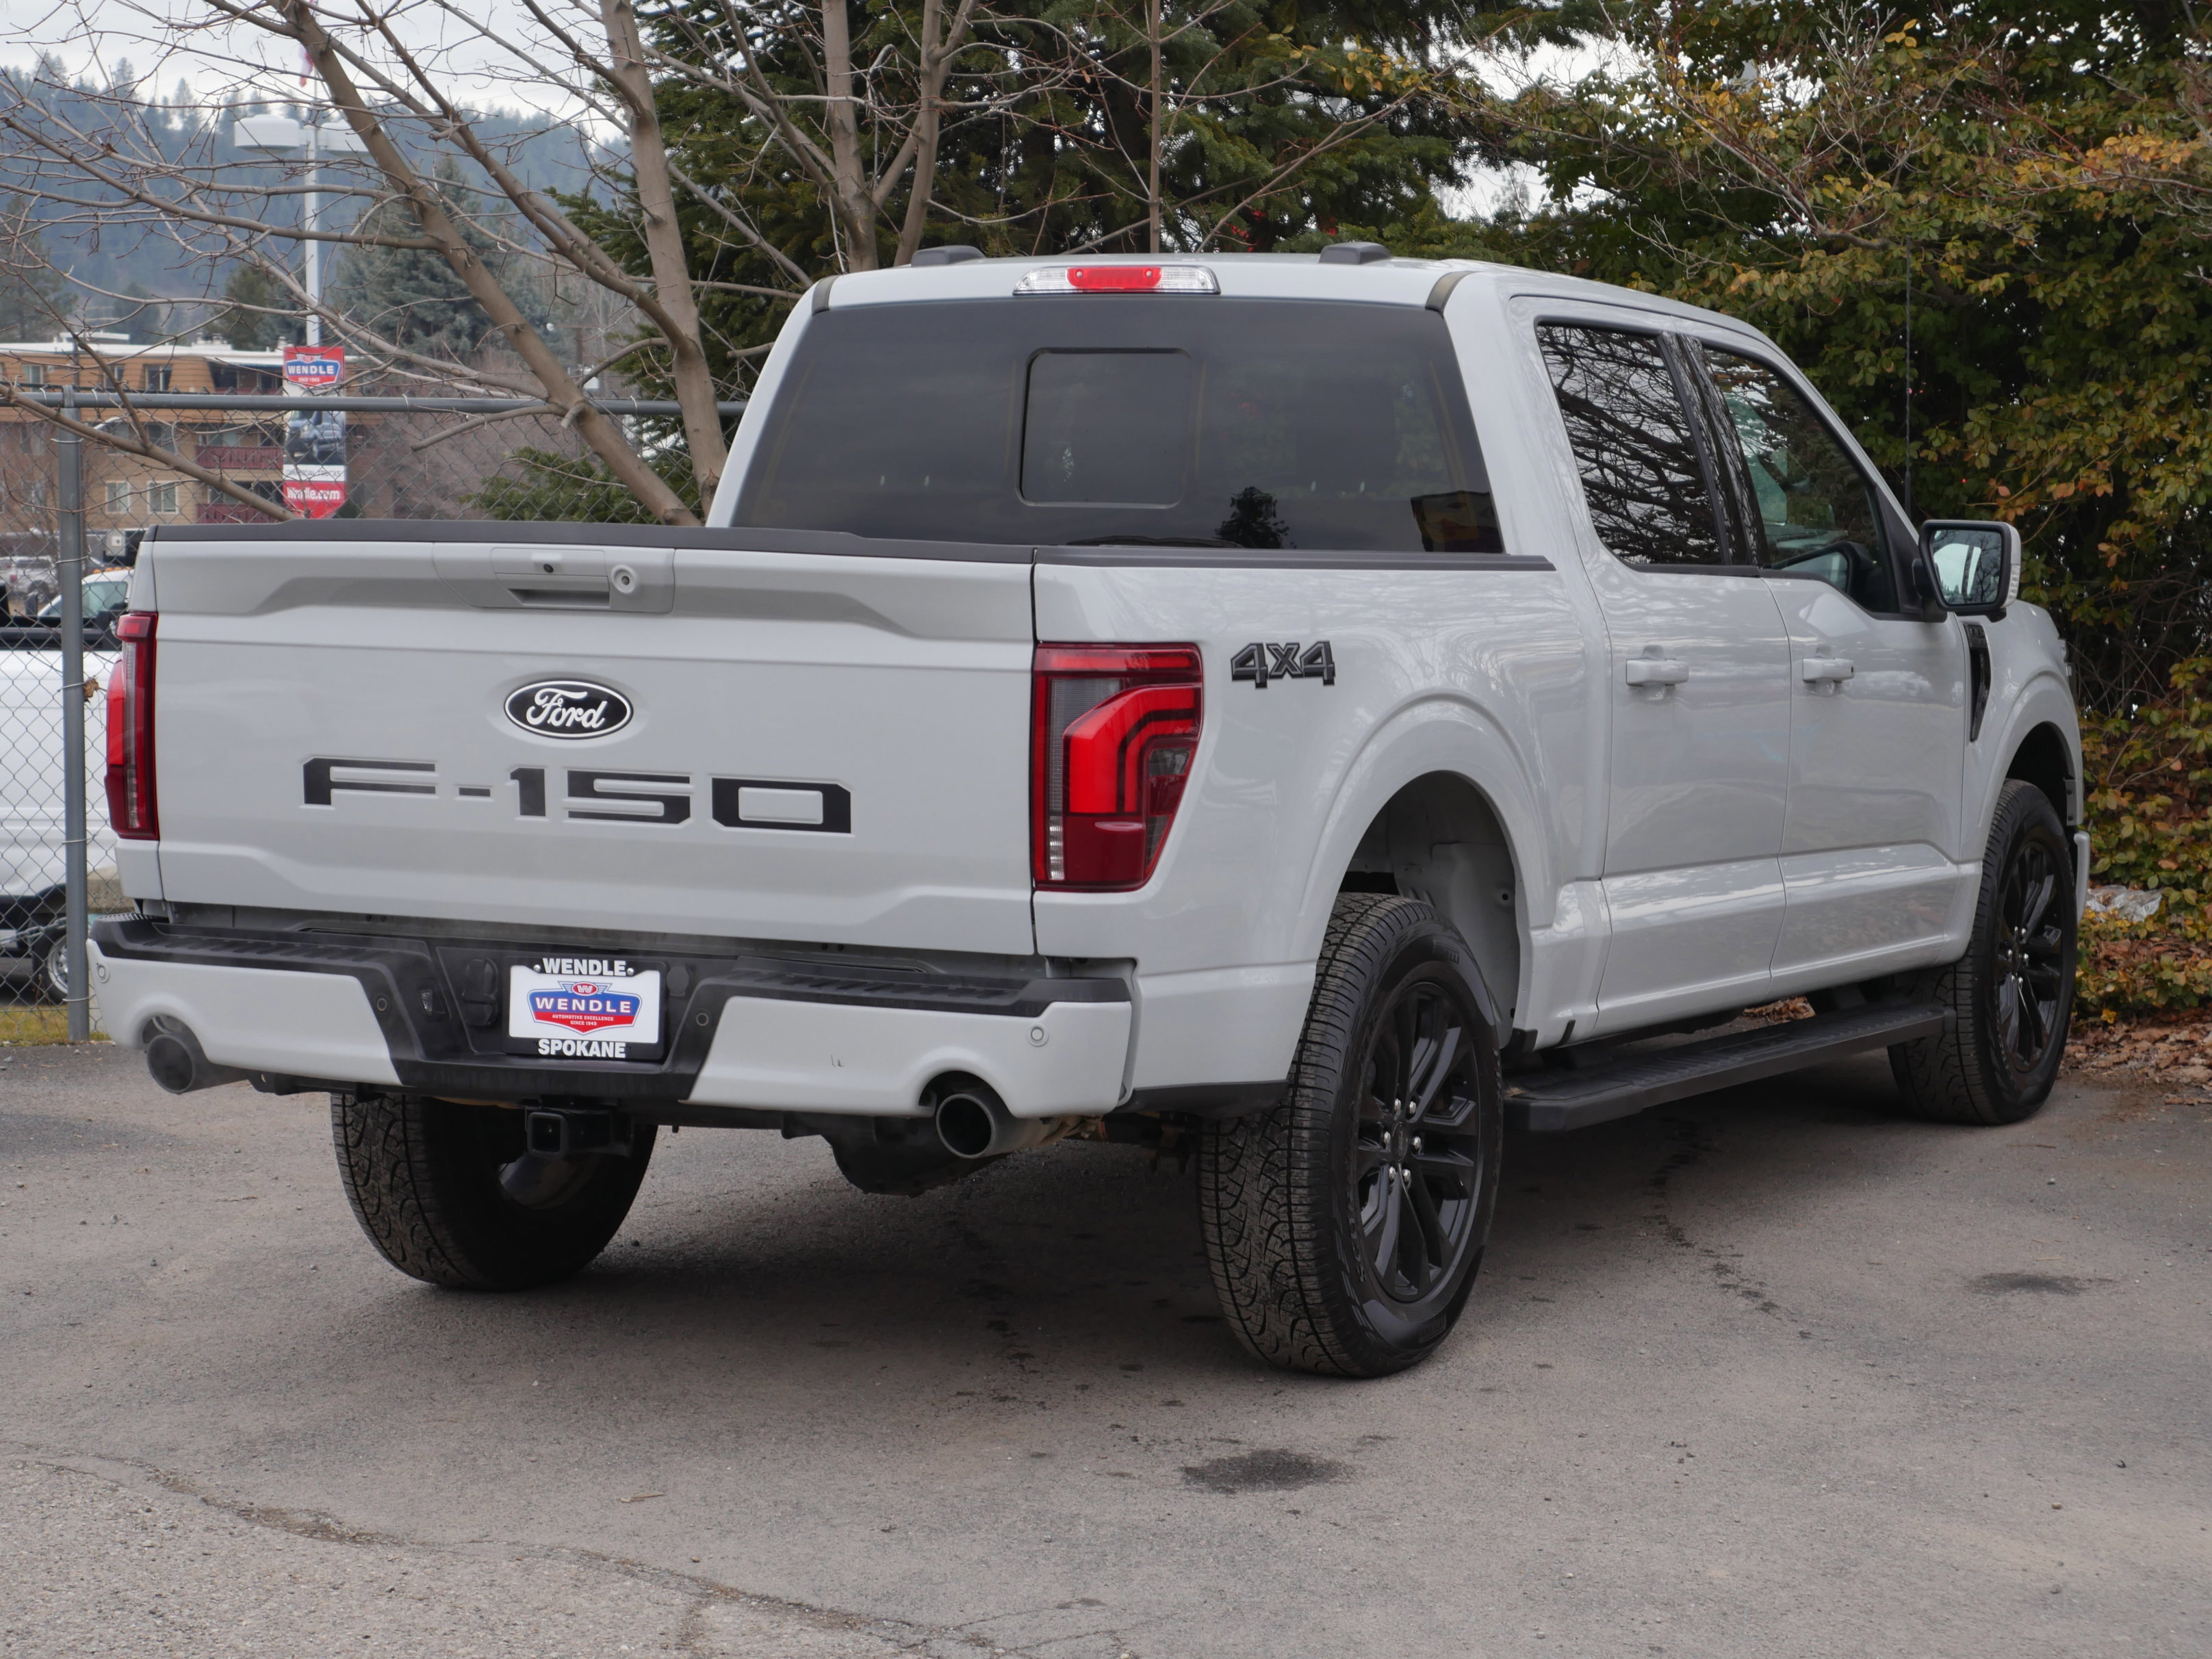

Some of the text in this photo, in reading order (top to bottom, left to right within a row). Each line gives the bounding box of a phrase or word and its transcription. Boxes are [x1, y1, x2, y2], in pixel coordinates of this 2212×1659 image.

[287, 365, 335, 374] WENDLE
[526, 688, 608, 730] Ford
[302, 756, 851, 835] F-150
[542, 957, 626, 977] WENDLE
[535, 996, 631, 1014] WENDLE
[537, 1038, 626, 1058] SPOKANE
